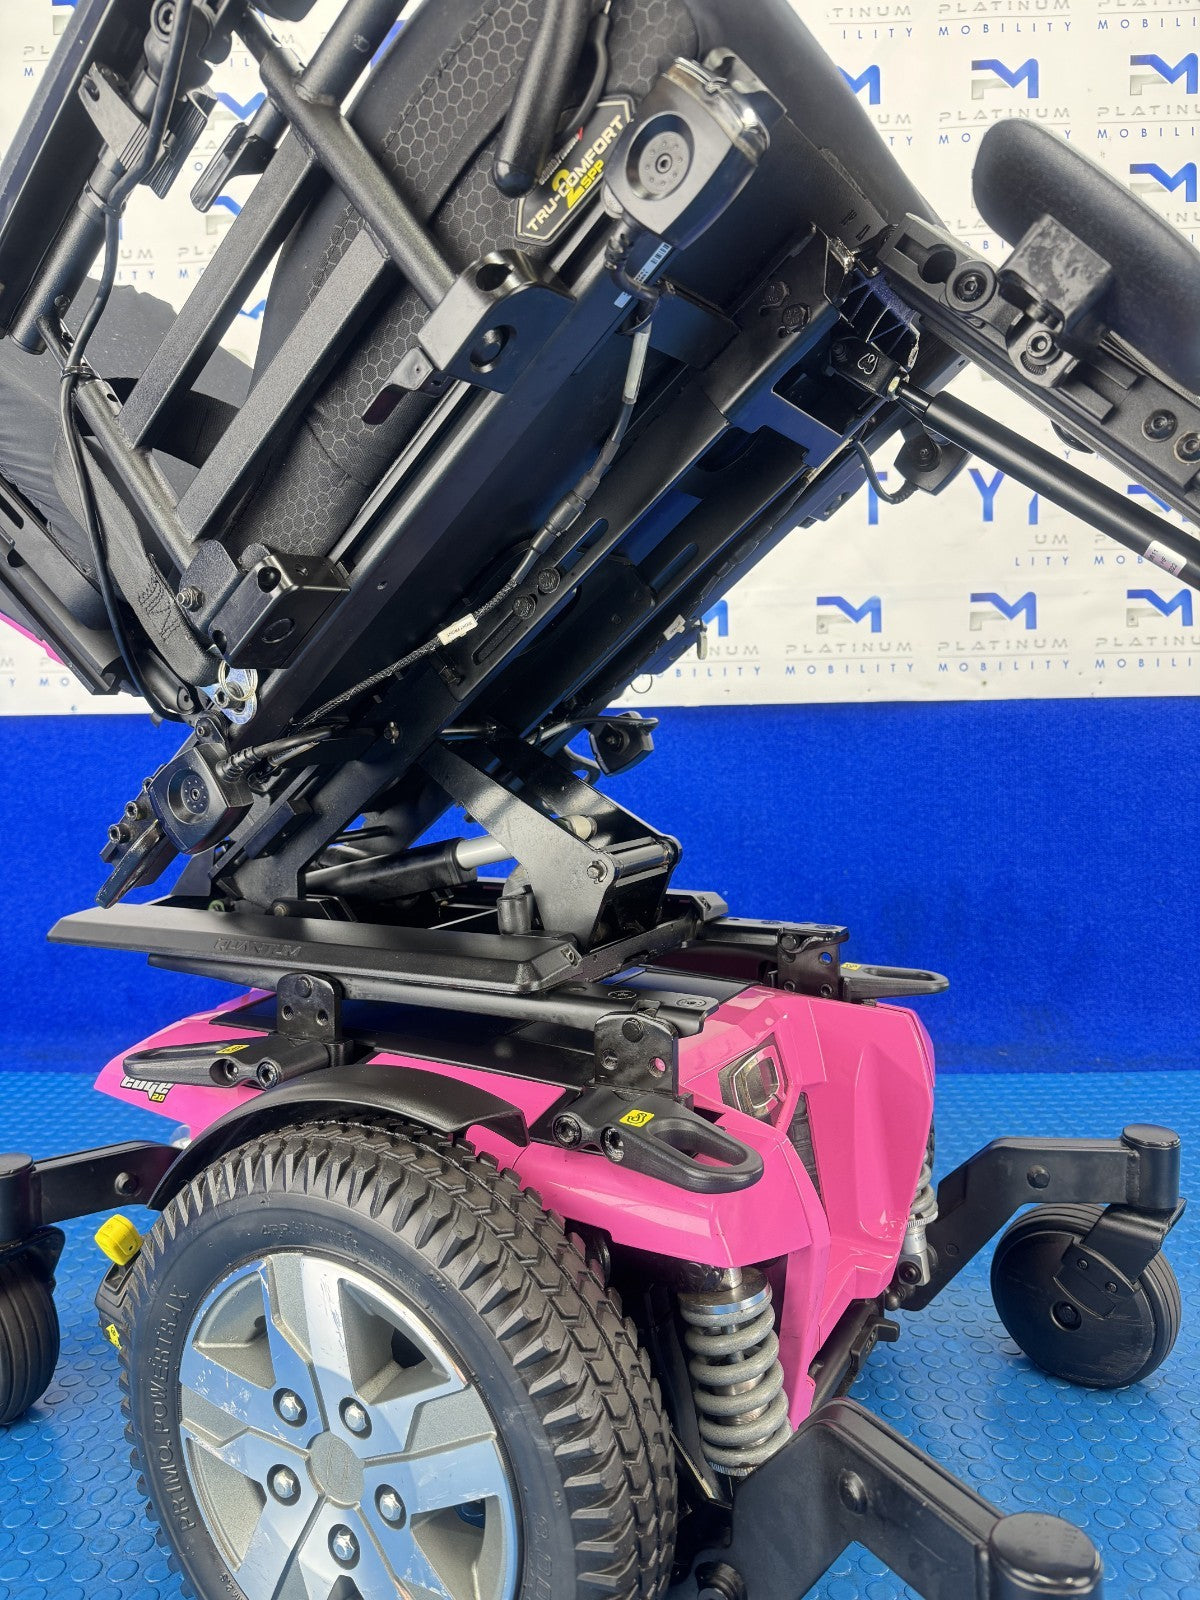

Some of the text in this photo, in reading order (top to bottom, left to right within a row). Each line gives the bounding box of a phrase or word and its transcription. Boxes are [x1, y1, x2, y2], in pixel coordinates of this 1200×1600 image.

[938, 0, 1070, 14] PLATINUM
[938, 22, 1071, 36] MOBILITY
[1097, 16, 1195, 30] MOBILI
[938, 107, 1070, 122] PLATINUM
[1096, 126, 1195, 139] MOBILI
[526, 114, 624, 232] TRU-COMFORT
[579, 159, 605, 191] SPP
[785, 641, 913, 654] PLATINUM
[937, 638, 1069, 652] PLATINUM
[1095, 635, 1200, 647] PLATINU
[785, 663, 914, 675] MOBILITY
[938, 660, 1070, 672] MOBILITY
[1095, 656, 1191, 669] MOBILI
